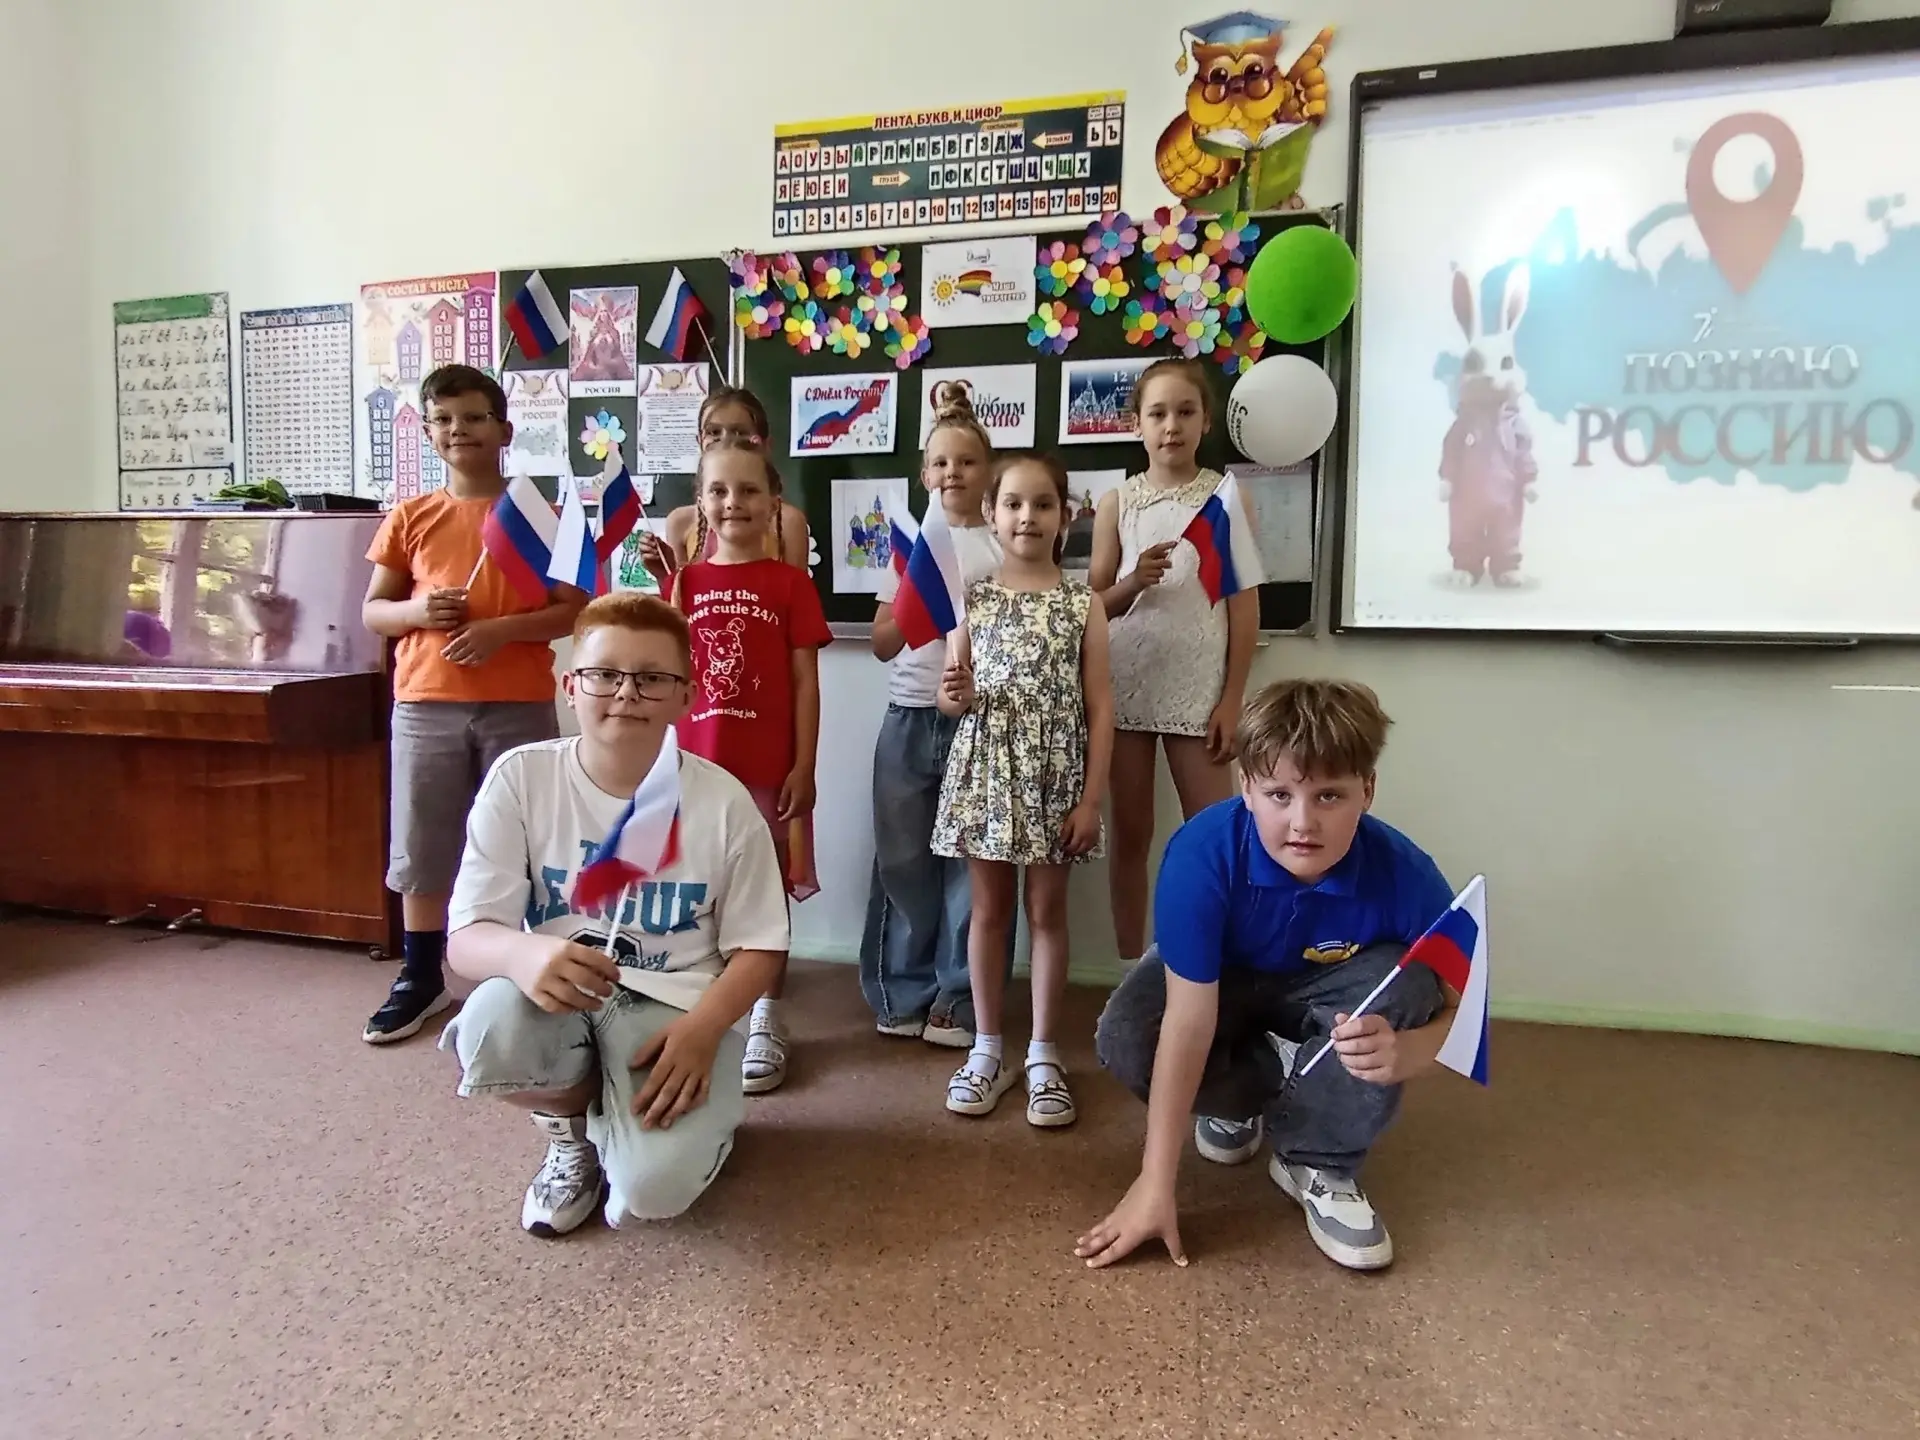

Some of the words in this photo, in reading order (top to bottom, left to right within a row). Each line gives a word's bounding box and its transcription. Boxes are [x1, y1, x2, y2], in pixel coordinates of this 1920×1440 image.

[874, 115, 914, 129] ЛЕНТА
[917, 111, 949, 124] БУКВ
[953, 109, 961, 121] И
[966, 106, 1003, 121] ЦИФР
[779, 155, 787, 170] А
[794, 153, 802, 168] О
[809, 152, 818, 167] У
[837, 150, 848, 164] Ы
[870, 147, 879, 161] Р
[884, 145, 894, 160] Л
[916, 142, 926, 157] Н
[931, 141, 940, 156] Б
[947, 140, 957, 155] В
[965, 138, 973, 153] Г
[1010, 134, 1023, 149] Ж
[931, 171, 940, 186] П
[945, 169, 957, 184] Ф
[963, 168, 973, 183] К
[981, 166, 989, 181] С
[996, 164, 1005, 179] Т
[1010, 164, 1022, 179] Ш
[1028, 162, 1038, 180] Ц
[1045, 160, 1053, 176] Ч
[1077, 158, 1087, 173] Х
[779, 185, 787, 199] Я
[806, 182, 817, 196] Ю
[823, 180, 830, 195] Е
[838, 179, 846, 194] И
[778, 217, 784, 229] 0
[794, 216, 799, 228] 1
[808, 214, 815, 226] 2
[824, 213, 831, 225] 3
[839, 212, 846, 224] 4
[855, 210, 862, 222] 5
[870, 210, 877, 222] 6
[887, 209, 893, 220] 7
[903, 206, 909, 219] 8
[919, 206, 926, 218] 9
[931, 205, 944, 217] 10
[951, 202, 961, 216] 11
[966, 202, 978, 214] 12
[983, 200, 995, 213] 13
[1000, 198, 1011, 211] 14
[1016, 197, 1029, 210] 15
[1034, 196, 1046, 210] 16
[1051, 195, 1063, 208] 17
[1068, 194, 1080, 207] 18
[1086, 192, 1099, 205] 19
[1103, 191, 1117, 205] 20
[387, 283, 426, 295] СОСТАВ
[429, 278, 470, 292] ЧИСЛА
[474, 296, 482, 307] 5
[440, 310, 448, 321] 4
[1113, 371, 1128, 383] 12
[805, 387, 812, 401] С
[813, 387, 842, 402] Днём
[378, 397, 385, 408] 6
[529, 399, 565, 407] РОДИНА
[975, 396, 1025, 418] юбим
[403, 413, 412, 424] 7
[522, 411, 558, 420] РОССИЯ
[1572, 398, 1914, 467] РОССИЮ
[187, 473, 195, 486] 0
[125, 493, 132, 507] 3
[157, 494, 164, 506] 5
[173, 493, 180, 506] 6
[693, 589, 732, 606] Being
[735, 589, 759, 602] the
[712, 602, 749, 614] cutie
[751, 606, 779, 626] 24/7
[744, 709, 757, 719] job
